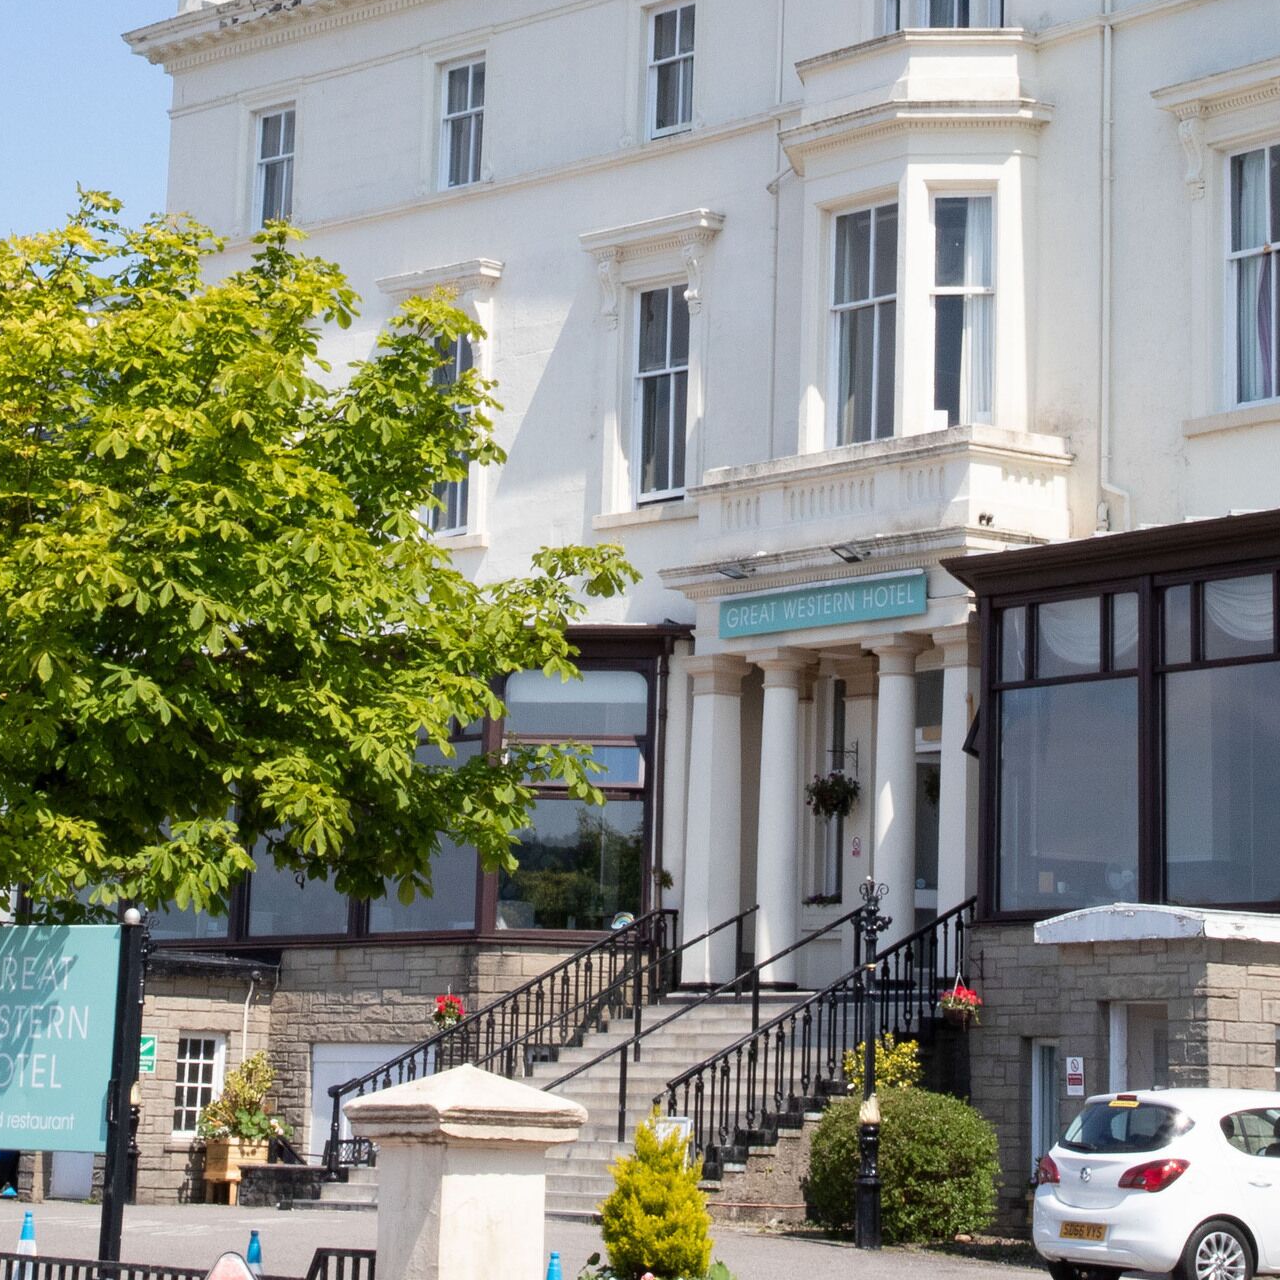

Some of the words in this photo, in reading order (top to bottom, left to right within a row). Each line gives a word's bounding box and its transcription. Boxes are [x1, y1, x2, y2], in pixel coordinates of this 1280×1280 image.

[726, 601, 777, 628] GREAT
[783, 591, 855, 620] WESTERN
[863, 583, 915, 609] HOTEL
[7, 1112, 75, 1131] restaurant
